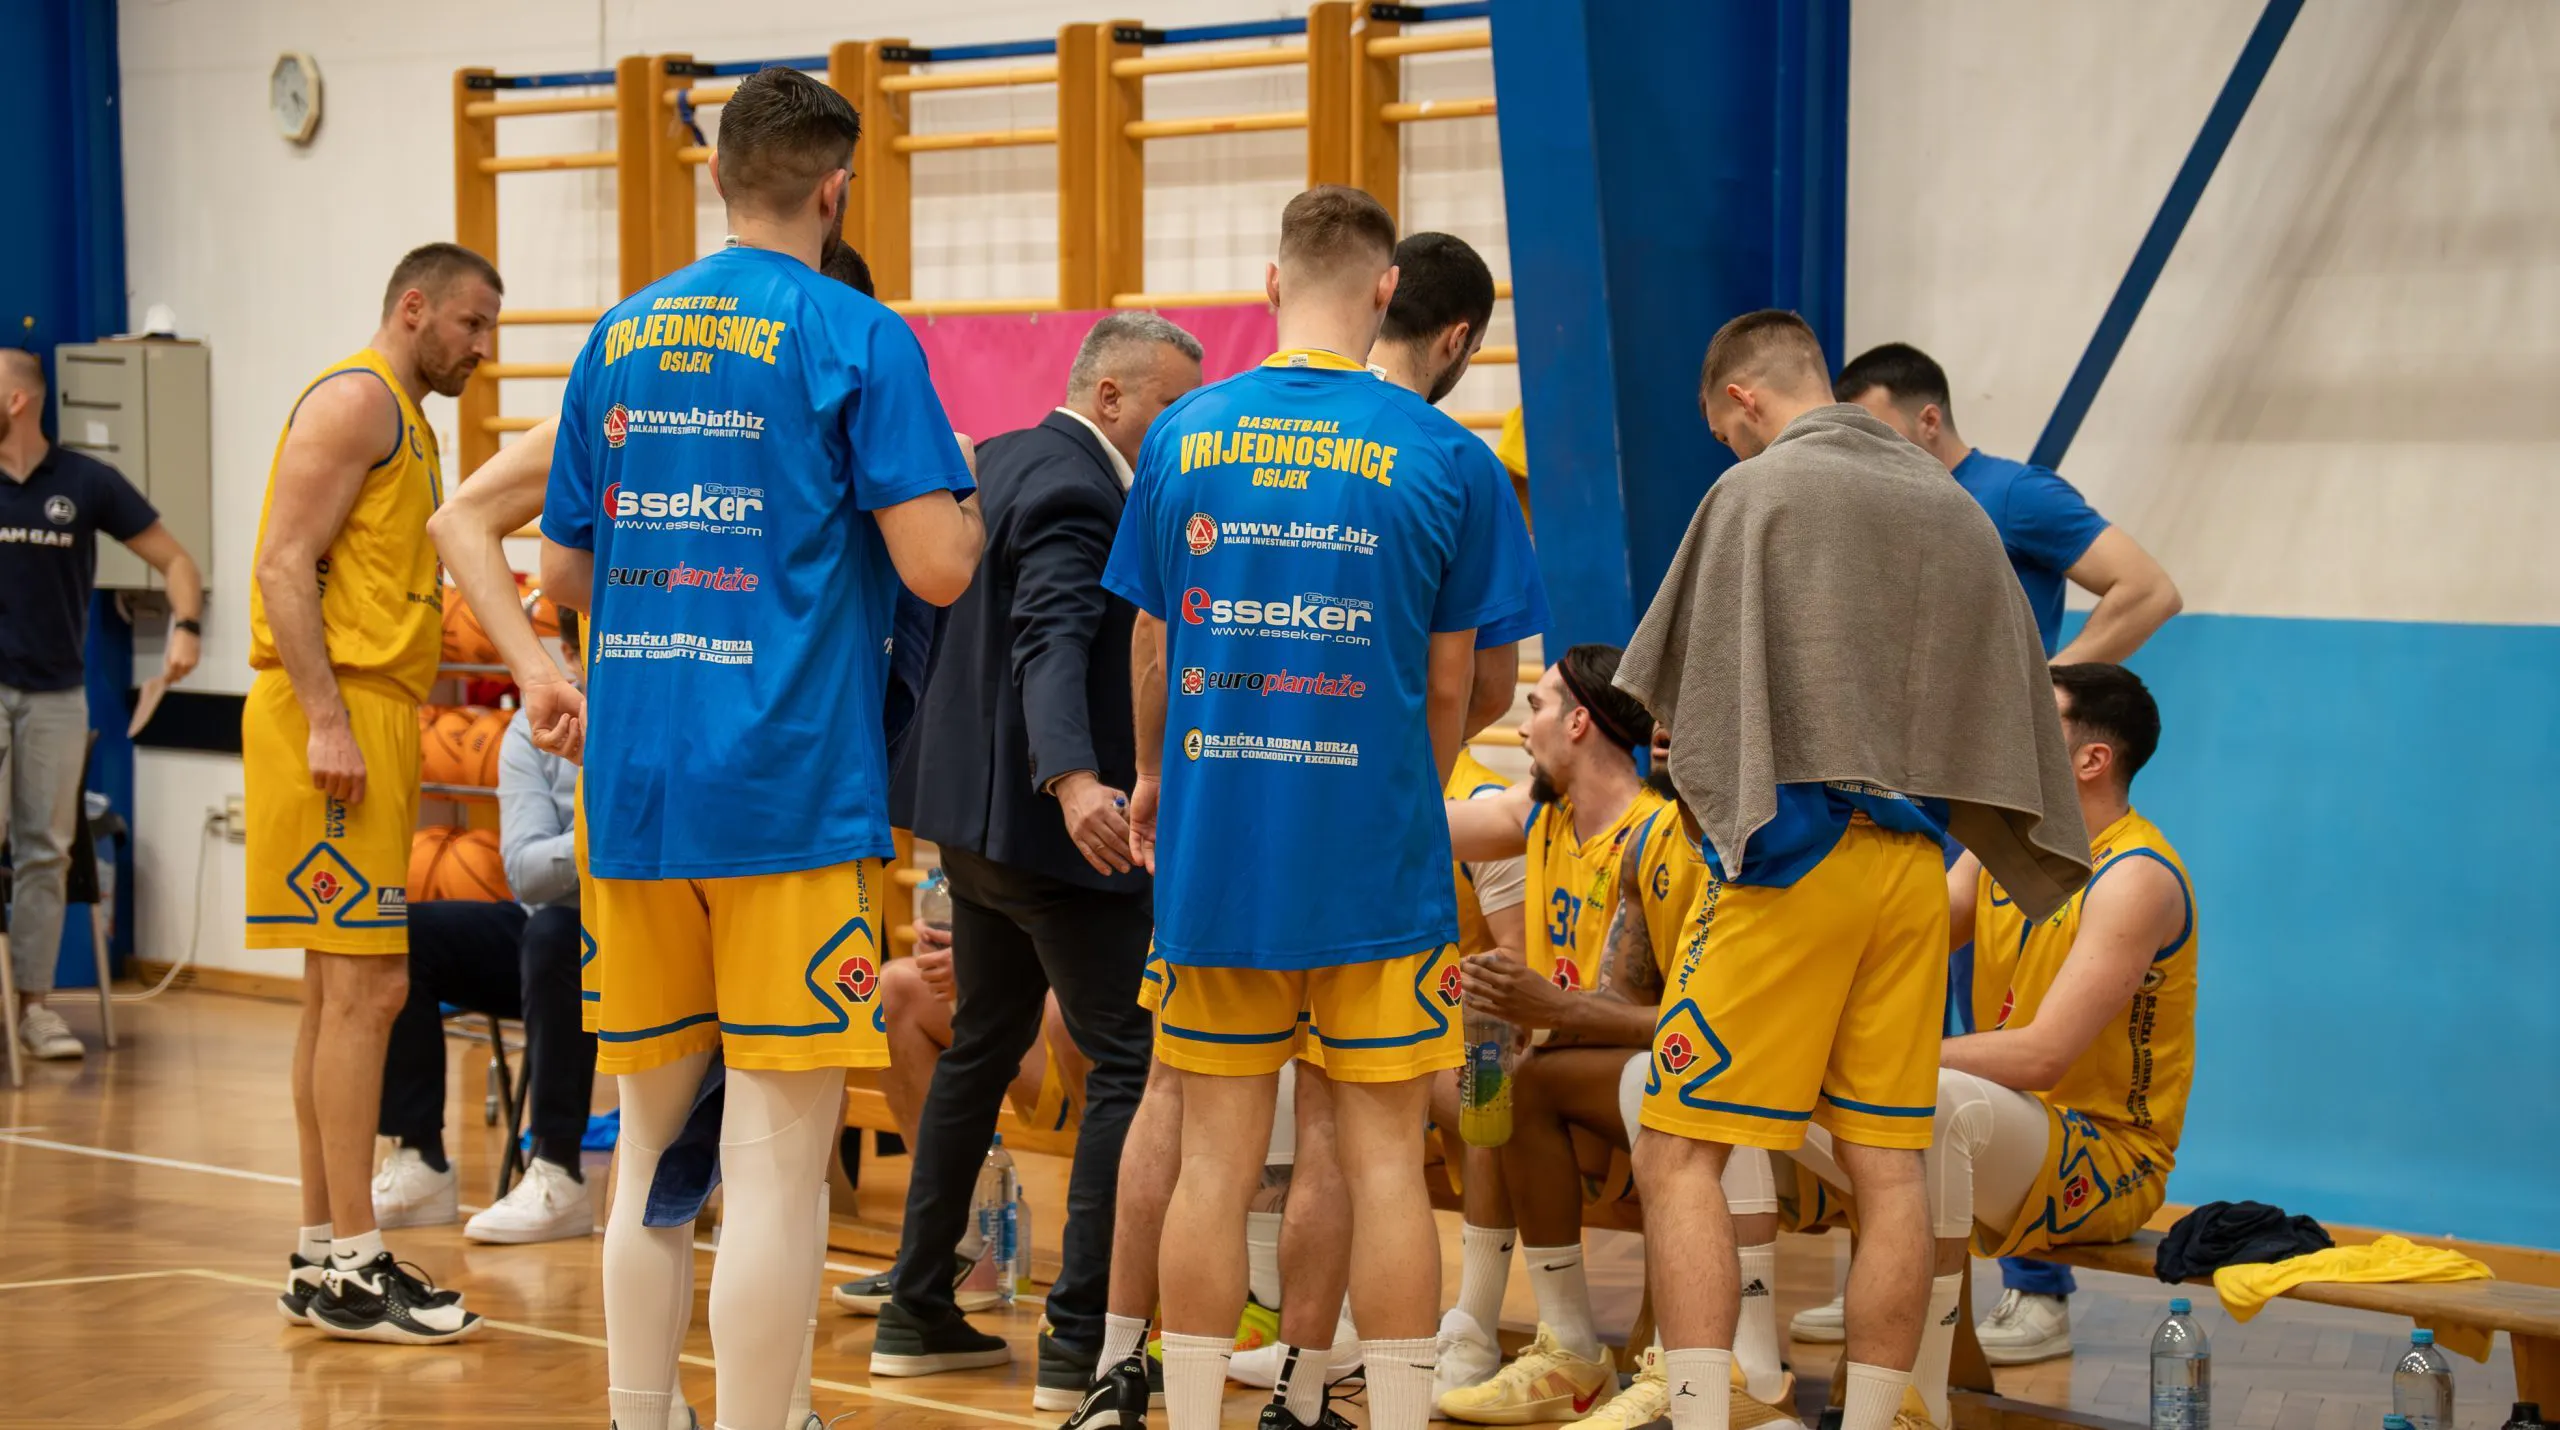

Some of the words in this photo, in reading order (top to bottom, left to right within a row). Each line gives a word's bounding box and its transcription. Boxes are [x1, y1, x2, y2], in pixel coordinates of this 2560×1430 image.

[652, 296, 739, 311] BASKETBALL
[605, 314, 785, 367] VRIJEDNOSNICE
[659, 351, 714, 374] OSIJEK
[628, 407, 765, 430] www.biofbiz
[1237, 415, 1340, 434] BASKETBALL
[628, 424, 658, 434] BALKAN
[740, 430, 760, 440] FUND
[1180, 430, 1398, 487] VRIJEDNOSNICE
[1252, 467, 1311, 490] OSIJEK
[1221, 522, 1379, 548] www.biof.biz
[1223, 536, 1250, 545] BALKAN
[1252, 537, 1299, 548] INVESTMENT
[1301, 540, 1352, 552] OPPORTUNITY
[1354, 545, 1374, 556] FUND
[1181, 586, 1372, 632] esseker
[1303, 592, 1374, 610] Grupa
[605, 631, 668, 646] OSJEČKA
[711, 638, 753, 652] BURZA
[1210, 627, 1371, 647] www.esseker.com
[699, 651, 753, 665] EXCHANGE
[1208, 668, 1366, 698] europlantaže
[1204, 732, 1264, 747] OSJEČKA
[1266, 736, 1312, 752] ROBNA
[1315, 741, 1359, 754] BURZA
[1241, 750, 1303, 763] COMMODITY
[1304, 755, 1358, 767] EXCHANGE
